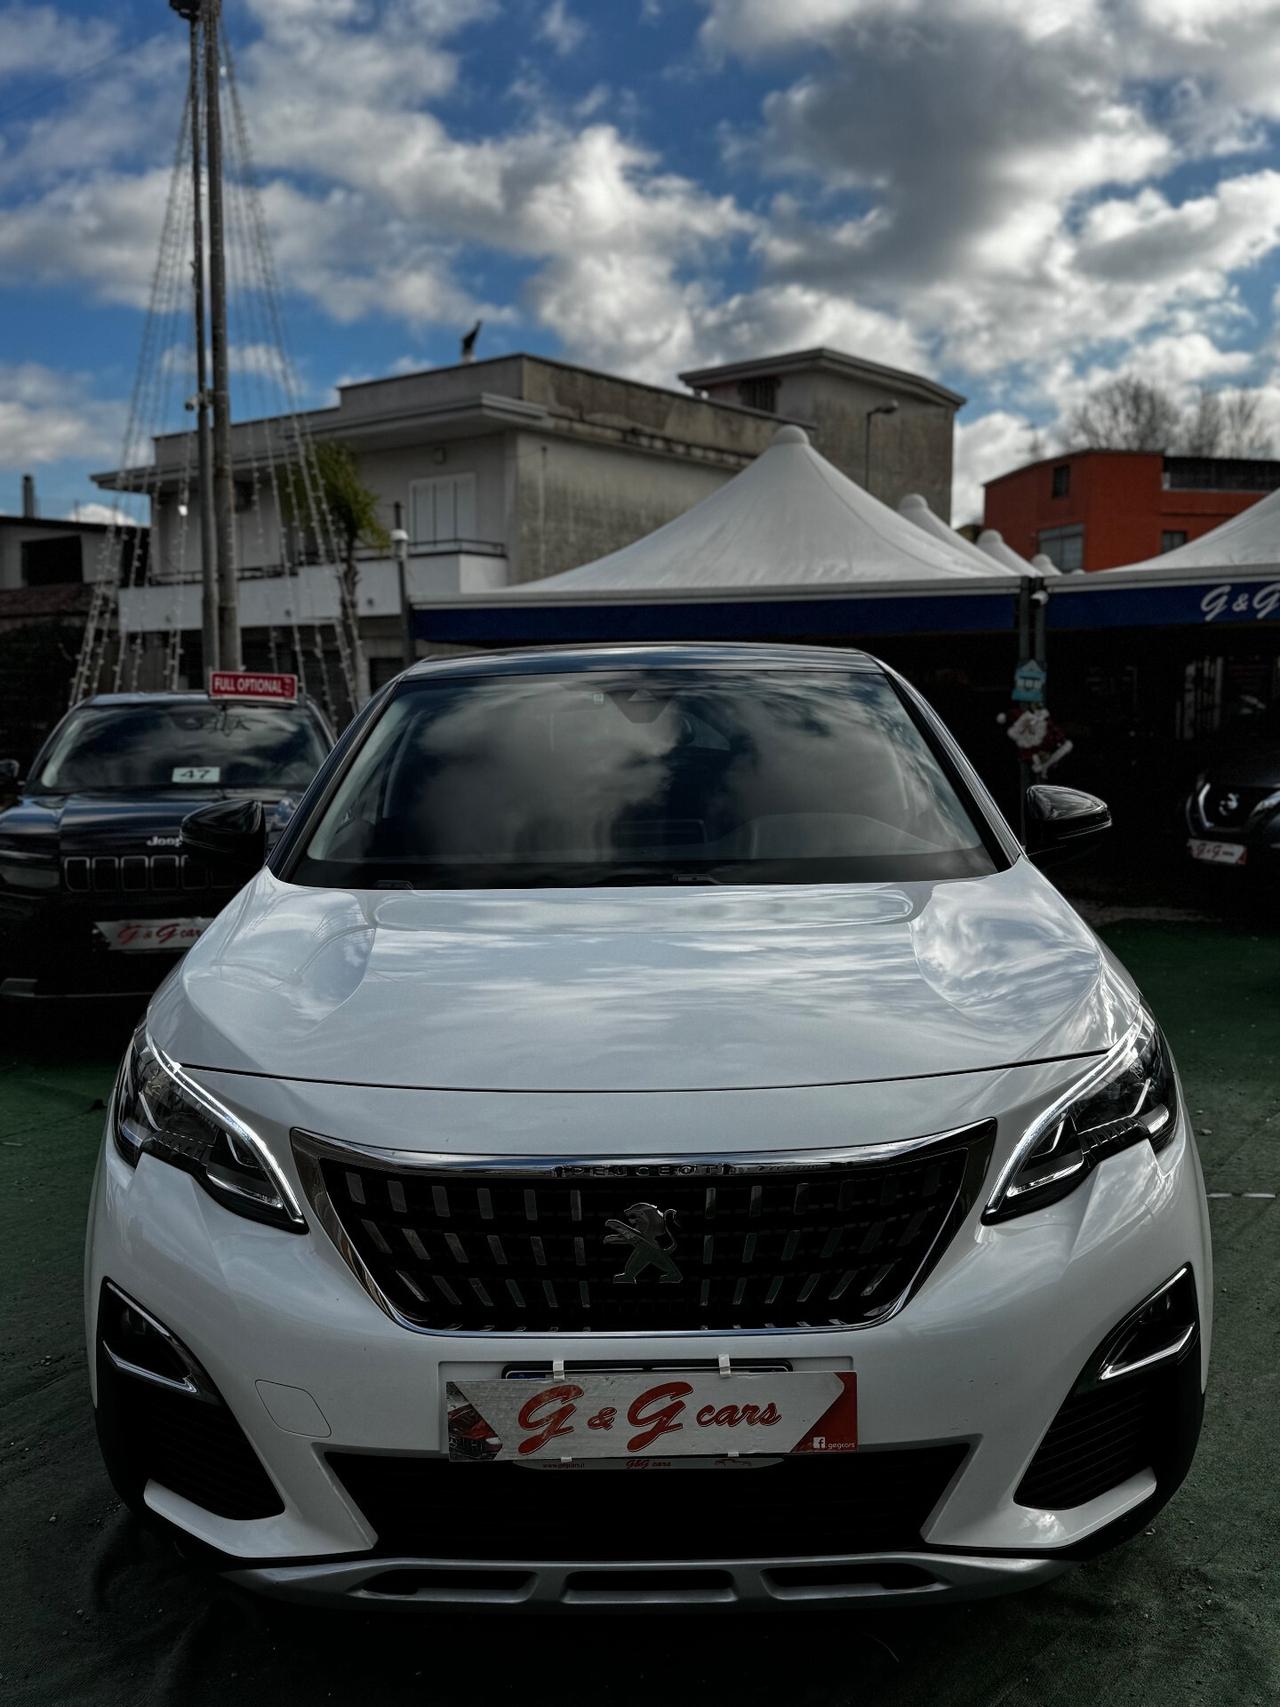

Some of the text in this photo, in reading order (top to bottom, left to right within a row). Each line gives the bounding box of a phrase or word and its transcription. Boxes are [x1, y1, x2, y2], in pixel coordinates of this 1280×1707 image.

[1201, 585, 1231, 622] G
[1232, 593, 1249, 612] &
[214, 677, 236, 691] FULL
[237, 678, 282, 693] OPTIONAL
[180, 769, 211, 779] 47
[156, 923, 180, 944] G
[571, 1163, 719, 1177] PEUGEOT
[518, 1381, 782, 1455] G & G cars
